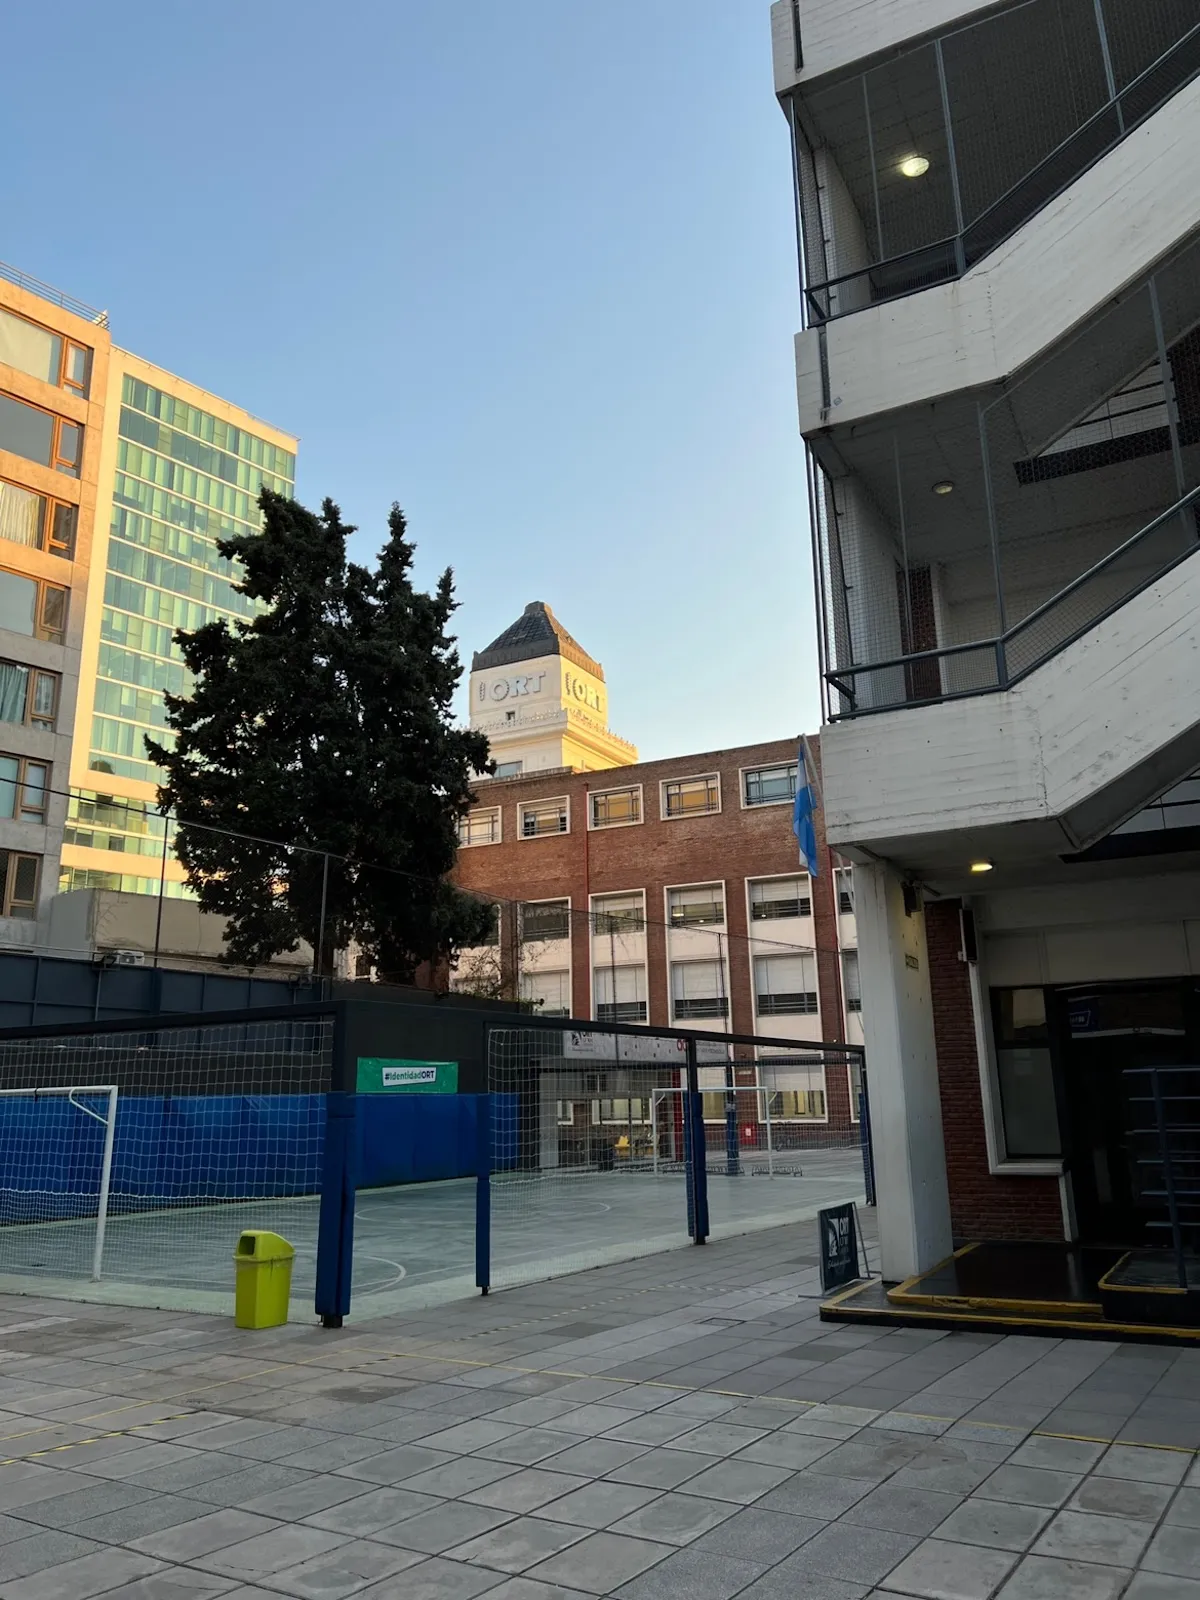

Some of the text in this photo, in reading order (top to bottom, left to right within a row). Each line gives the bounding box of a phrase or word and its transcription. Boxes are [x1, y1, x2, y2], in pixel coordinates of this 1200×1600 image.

[489, 671, 546, 702] ORT
[572, 678, 605, 713] ORT
[384, 1070, 435, 1081] #IdentidadORT
